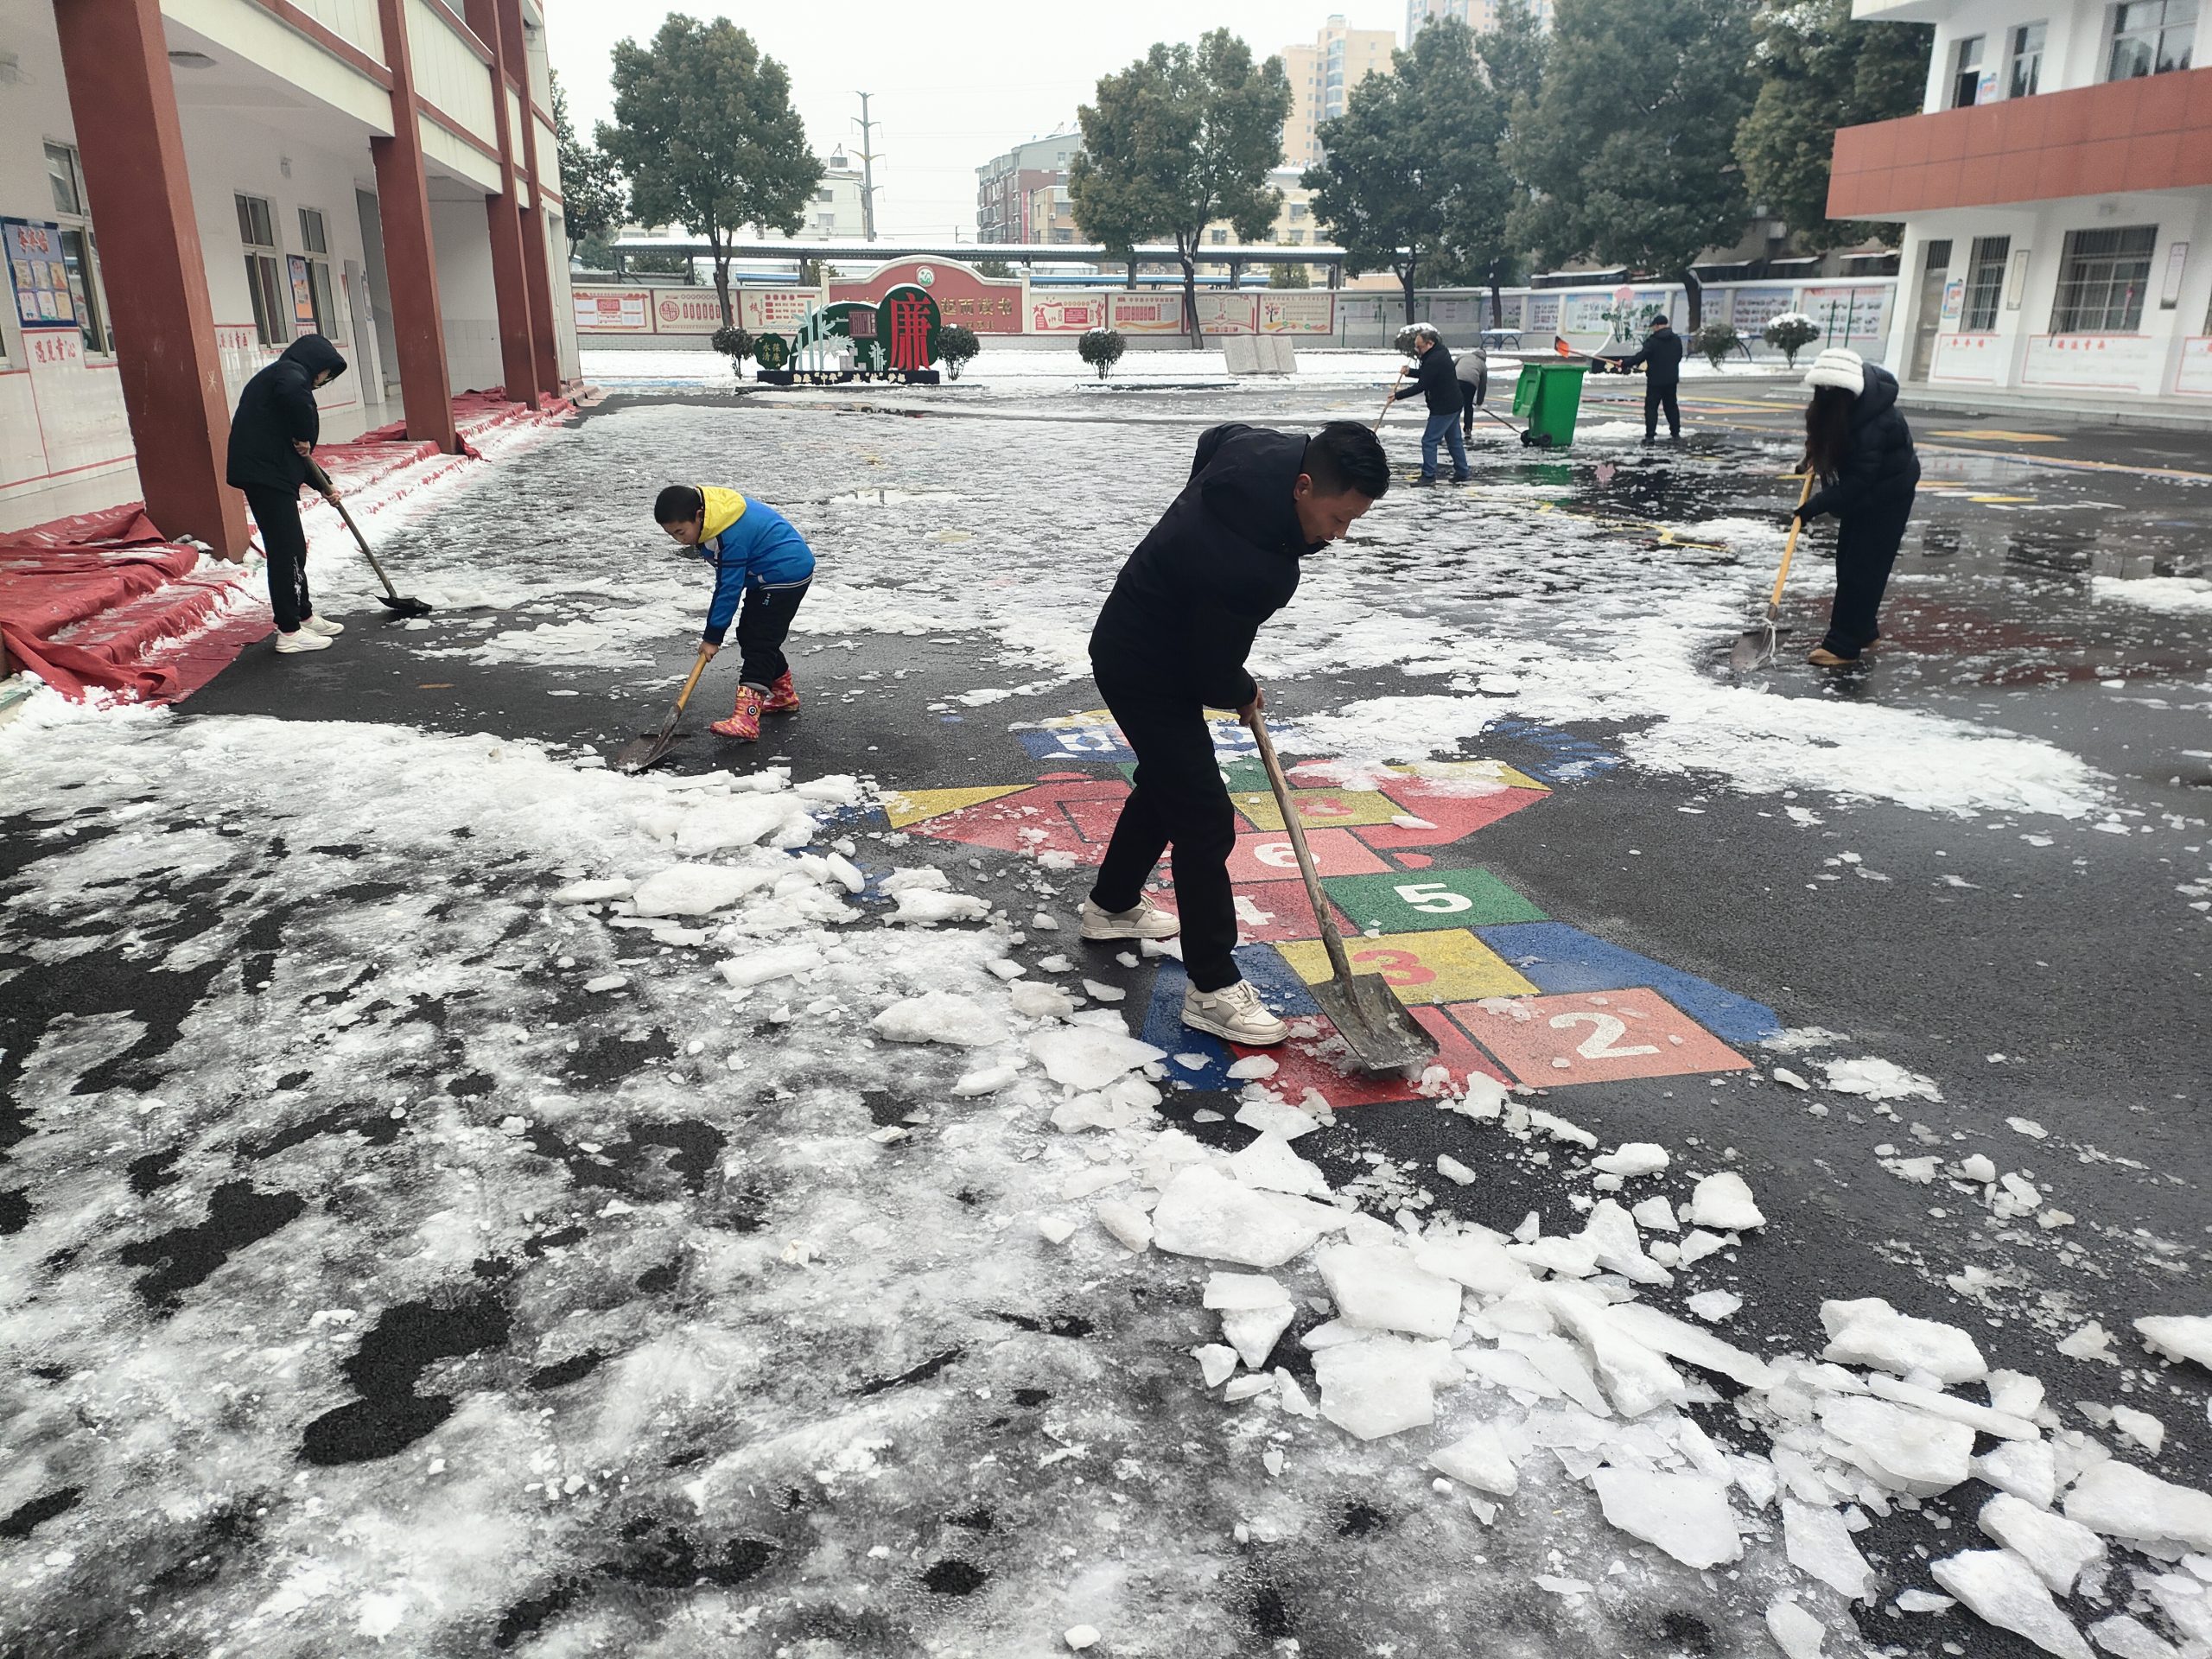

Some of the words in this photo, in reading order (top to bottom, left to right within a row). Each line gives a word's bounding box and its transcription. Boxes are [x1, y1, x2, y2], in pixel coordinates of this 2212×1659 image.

[890, 292, 932, 371] 廉
[1254, 842, 1321, 868] 6
[1393, 883, 1473, 914] 5
[1352, 950, 1436, 986] 3
[1548, 1012, 1661, 1059] 2
